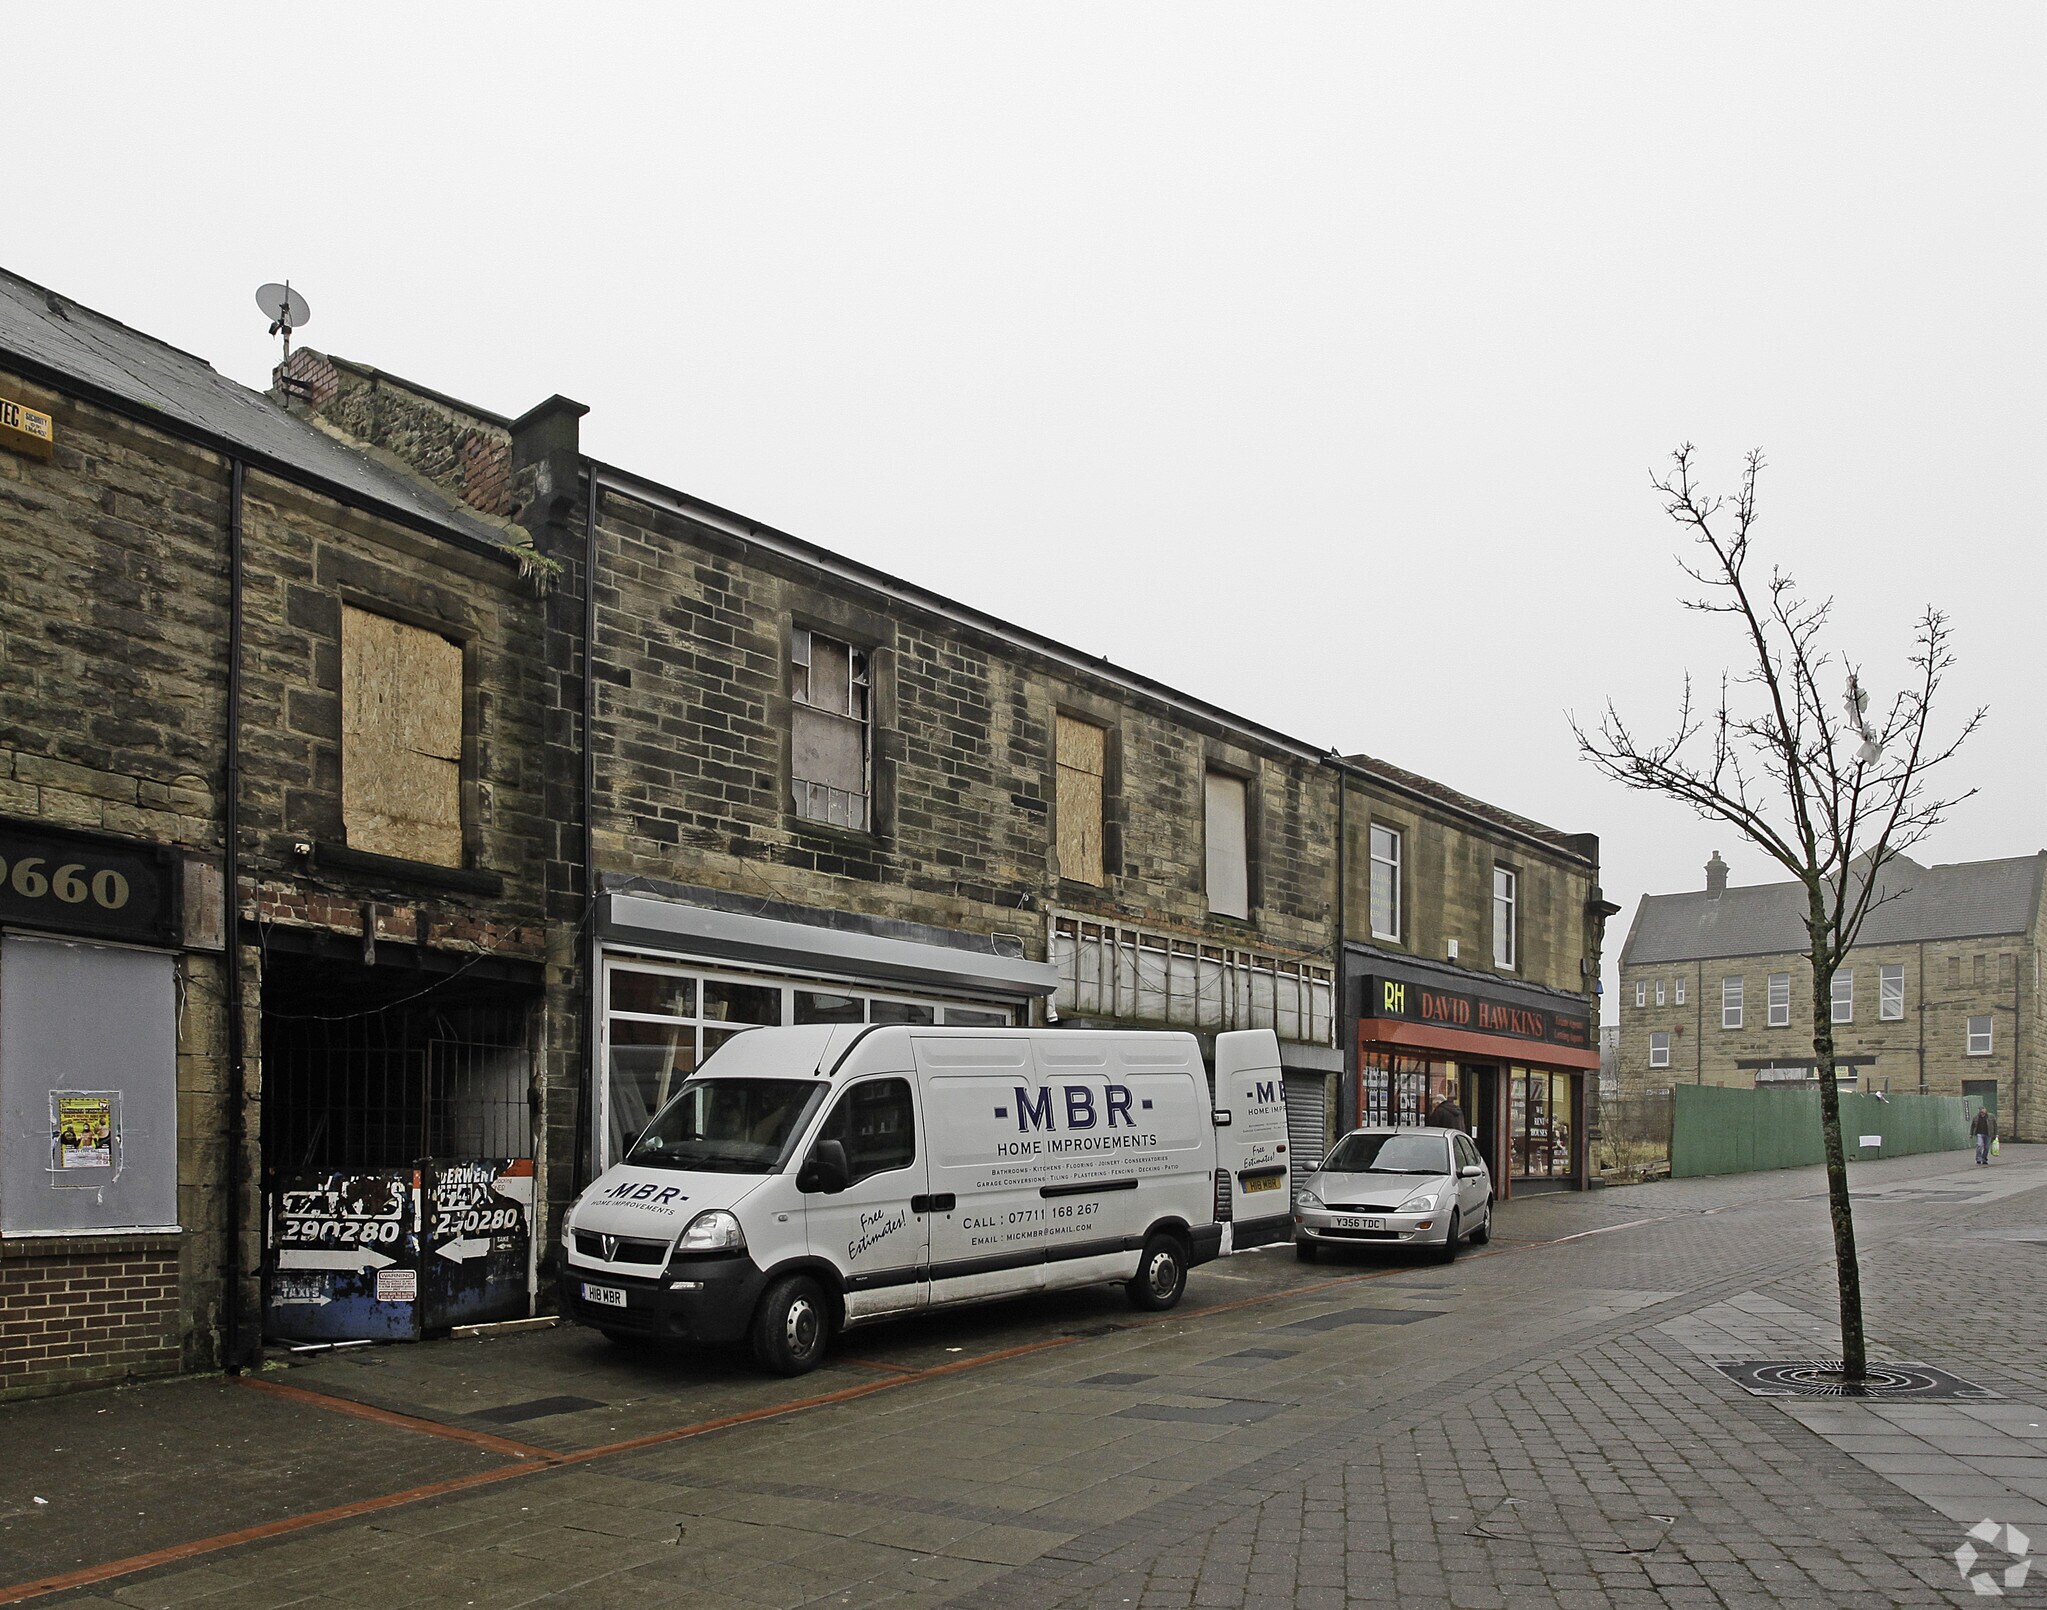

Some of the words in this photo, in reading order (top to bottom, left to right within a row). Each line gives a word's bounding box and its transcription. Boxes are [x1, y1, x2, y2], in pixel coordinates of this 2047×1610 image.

[0, 855, 130, 910] 660
[1421, 992, 1470, 1024] DAVID
[1478, 1002, 1543, 1037] HAWKINS
[1248, 1107, 1269, 1115] HOME
[997, 1141, 1041, 1156] HOME
[1047, 1134, 1157, 1153] IMPROVEMENTS
[1252, 1145, 1265, 1156] Free
[991, 1167, 1028, 1176] BATHROOMS
[1066, 1162, 1094, 1170] FLOORING
[1124, 1156, 1168, 1164] CONSERVATORIES
[976, 1180, 1002, 1188] GARAGE
[1003, 1177, 1046, 1185] CONVERSIONS
[612, 1201, 676, 1216] IMPROVEMENTS
[1008, 1209, 1045, 1224] 07711
[1052, 1206, 1073, 1219] 168
[1077, 1203, 1099, 1216] 267
[860, 1209, 884, 1233] Free
[1336, 1217, 1360, 1228] Y356
[1362, 1219, 1380, 1228] TDC
[281, 1220, 400, 1243] 290280
[848, 1209, 906, 1260] Estimates!
[603, 1289, 621, 1305] MBR
